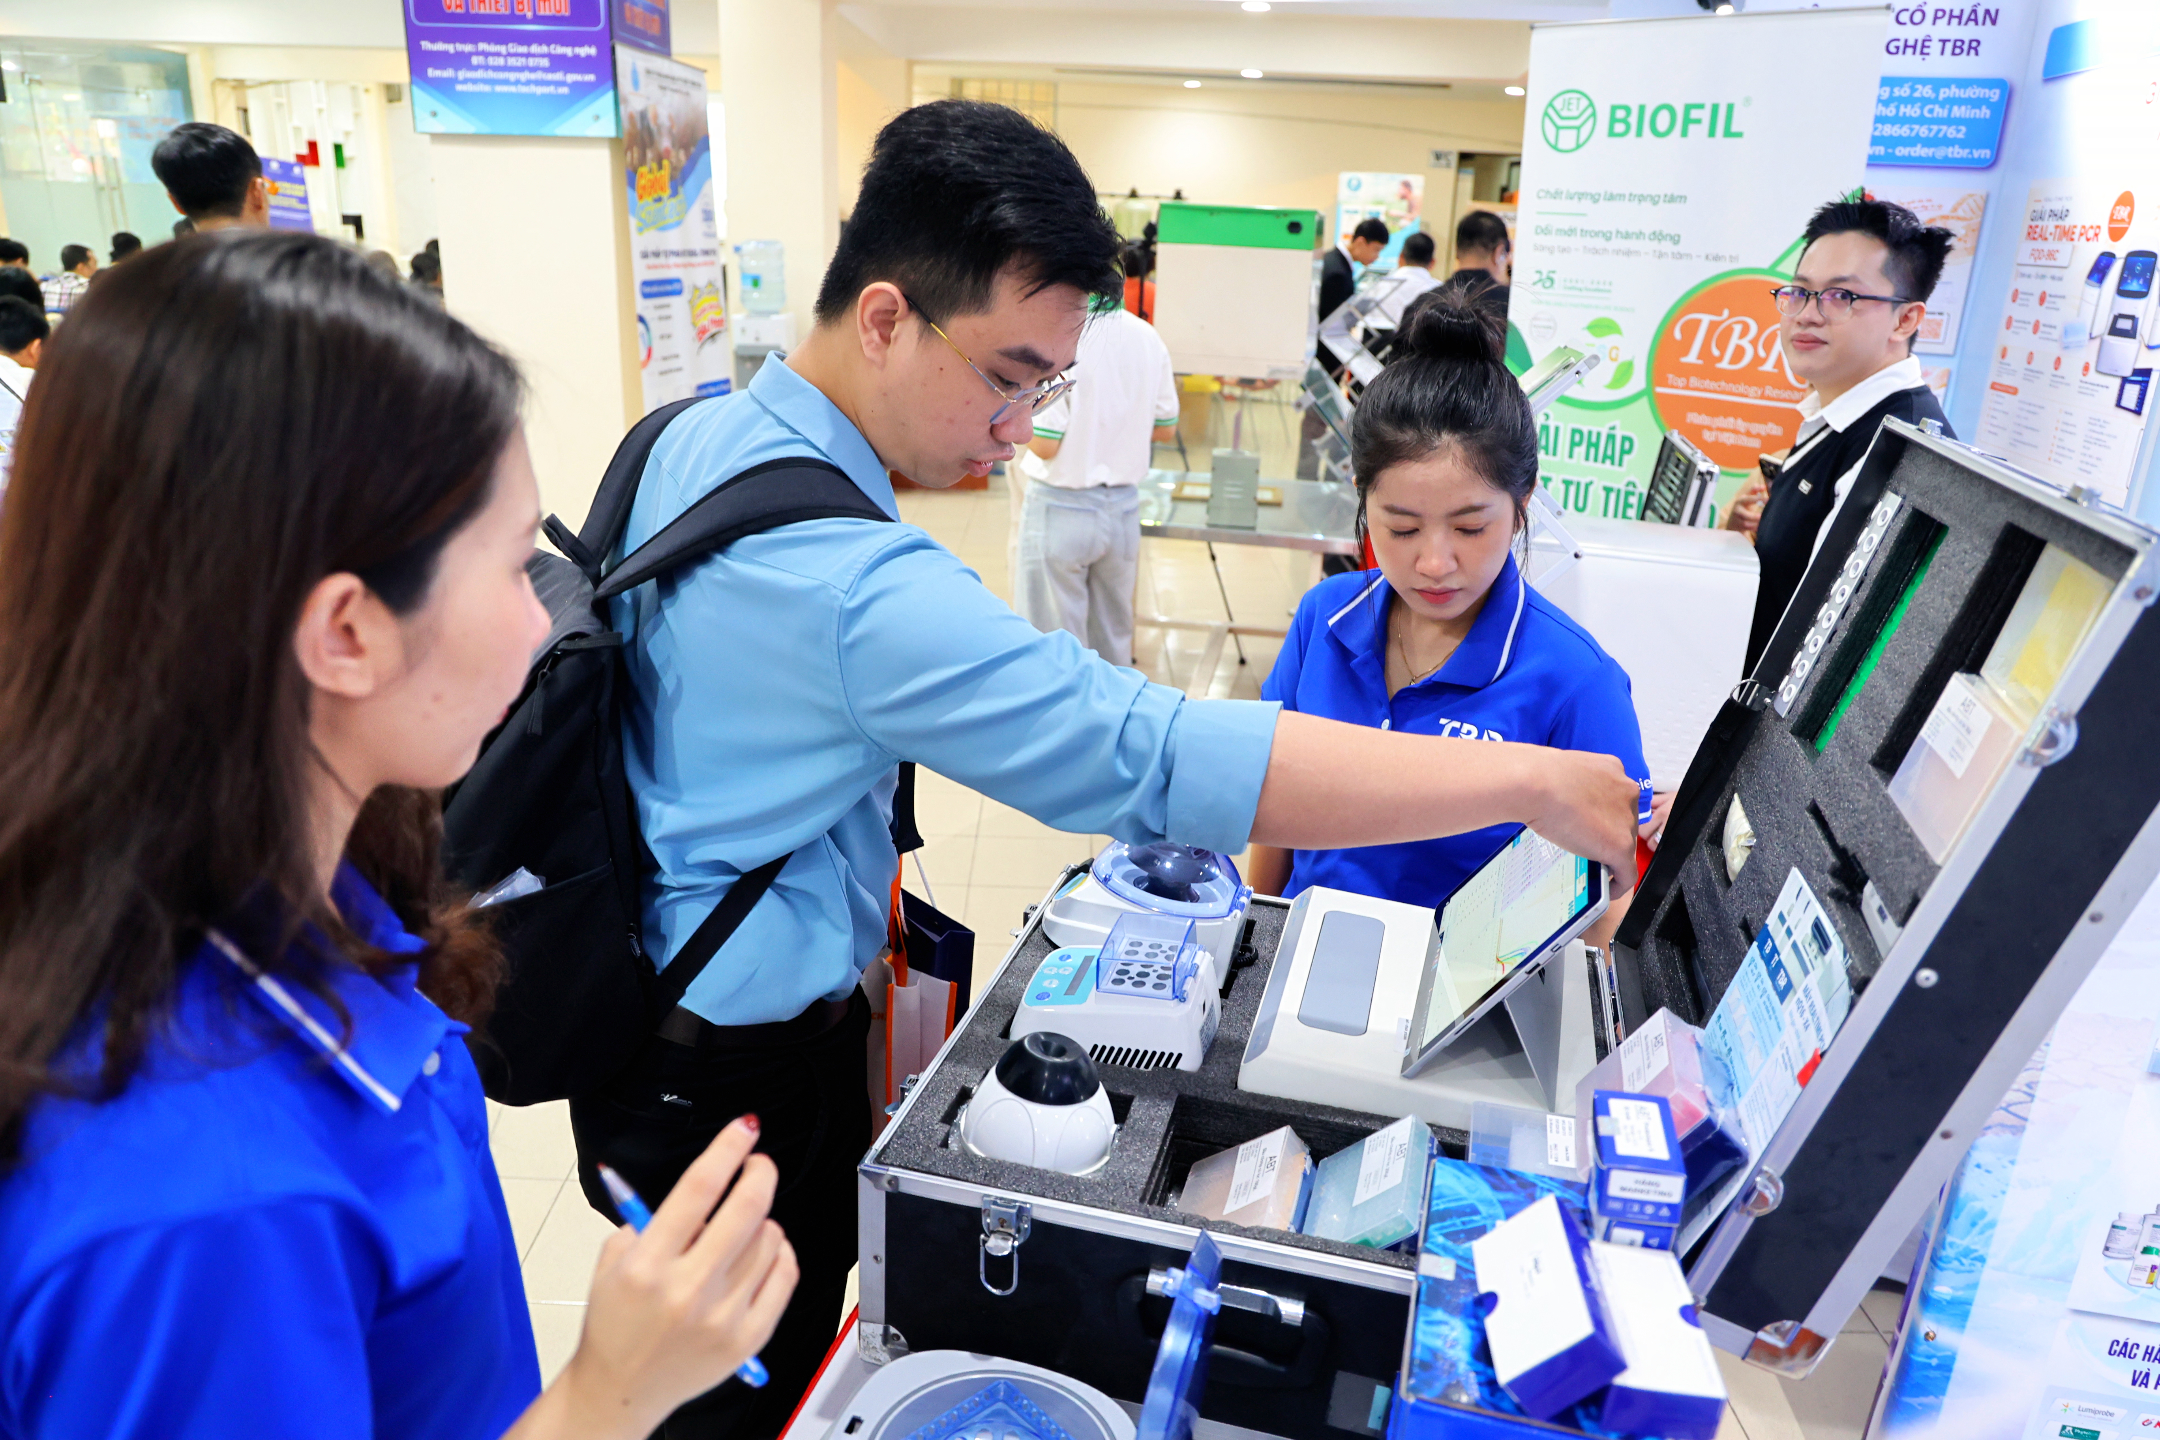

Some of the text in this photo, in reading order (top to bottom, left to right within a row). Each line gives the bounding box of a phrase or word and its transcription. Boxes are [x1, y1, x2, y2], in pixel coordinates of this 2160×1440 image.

[1894, 1, 2000, 27] CỔ PHẦN
[1938, 38, 1982, 57] TBR
[1892, 82, 1912, 97] số
[1912, 84, 1936, 99] 26,
[1938, 83, 2000, 102] phường
[1559, 97, 1582, 112] JET
[1950, 105, 1991, 119] Minh
[1607, 103, 1744, 138] BIOFIL
[1895, 143, 1991, 159] order@tbr.vn
[1580, 227, 1612, 241] trong
[2025, 225, 2101, 242] REAL-TIME PCR
[1667, 374, 1687, 388] Top
[1689, 376, 1763, 399] Biotechnology
[1568, 420, 1635, 467] PHÁP
[1561, 478, 1593, 513] TƯ
[1396, 1142, 1407, 1163] ABT
[1264, 1154, 1276, 1175] ABT
[2107, 1338, 2140, 1360] CÁC
[2131, 1368, 2151, 1389] VÀ
[2077, 1404, 2116, 1418] Lumiprobe
